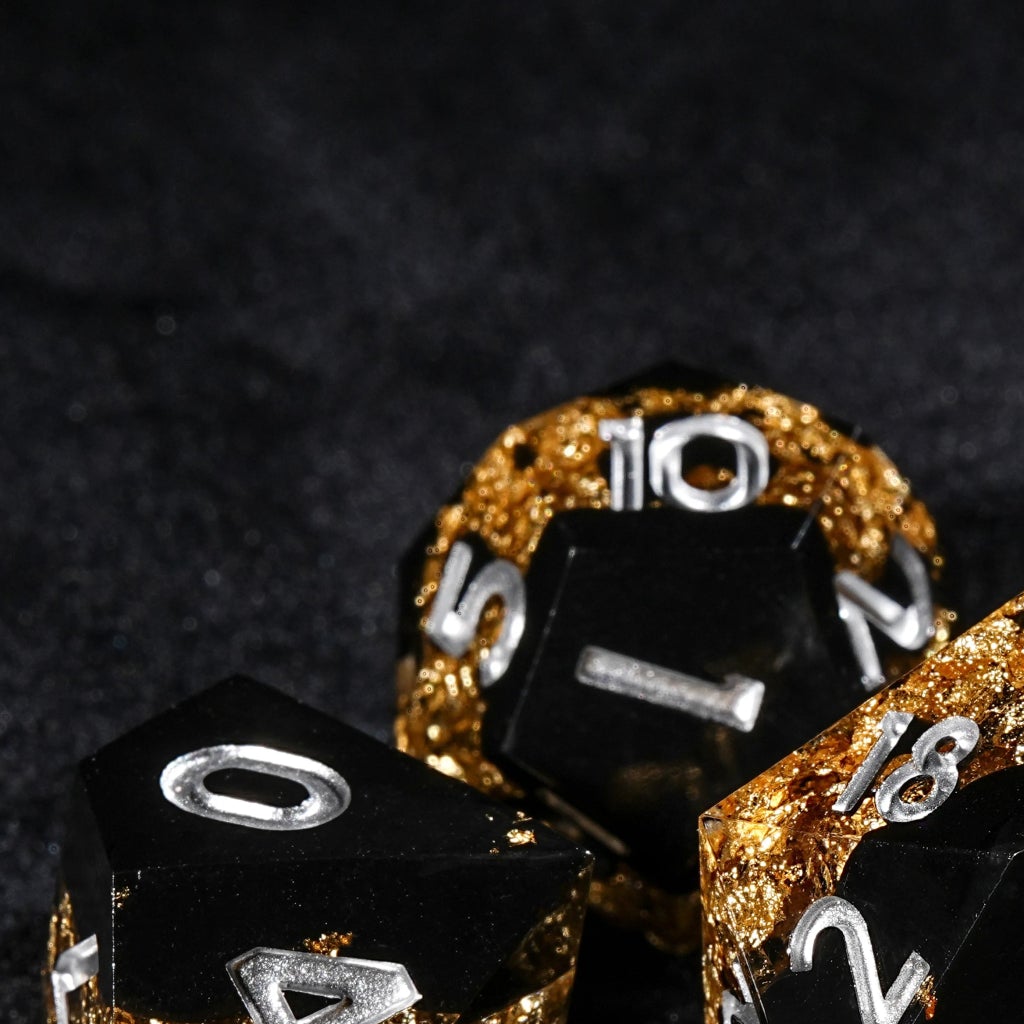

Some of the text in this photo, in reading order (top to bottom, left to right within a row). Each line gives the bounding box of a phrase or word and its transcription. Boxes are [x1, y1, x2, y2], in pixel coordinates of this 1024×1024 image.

[600, 413, 770, 513] 10
[430, 540, 527, 687] 5
[835, 532, 934, 692] 2
[575, 645, 765, 733] 1
[159, 744, 352, 831] 0
[832, 710, 980, 823] 18
